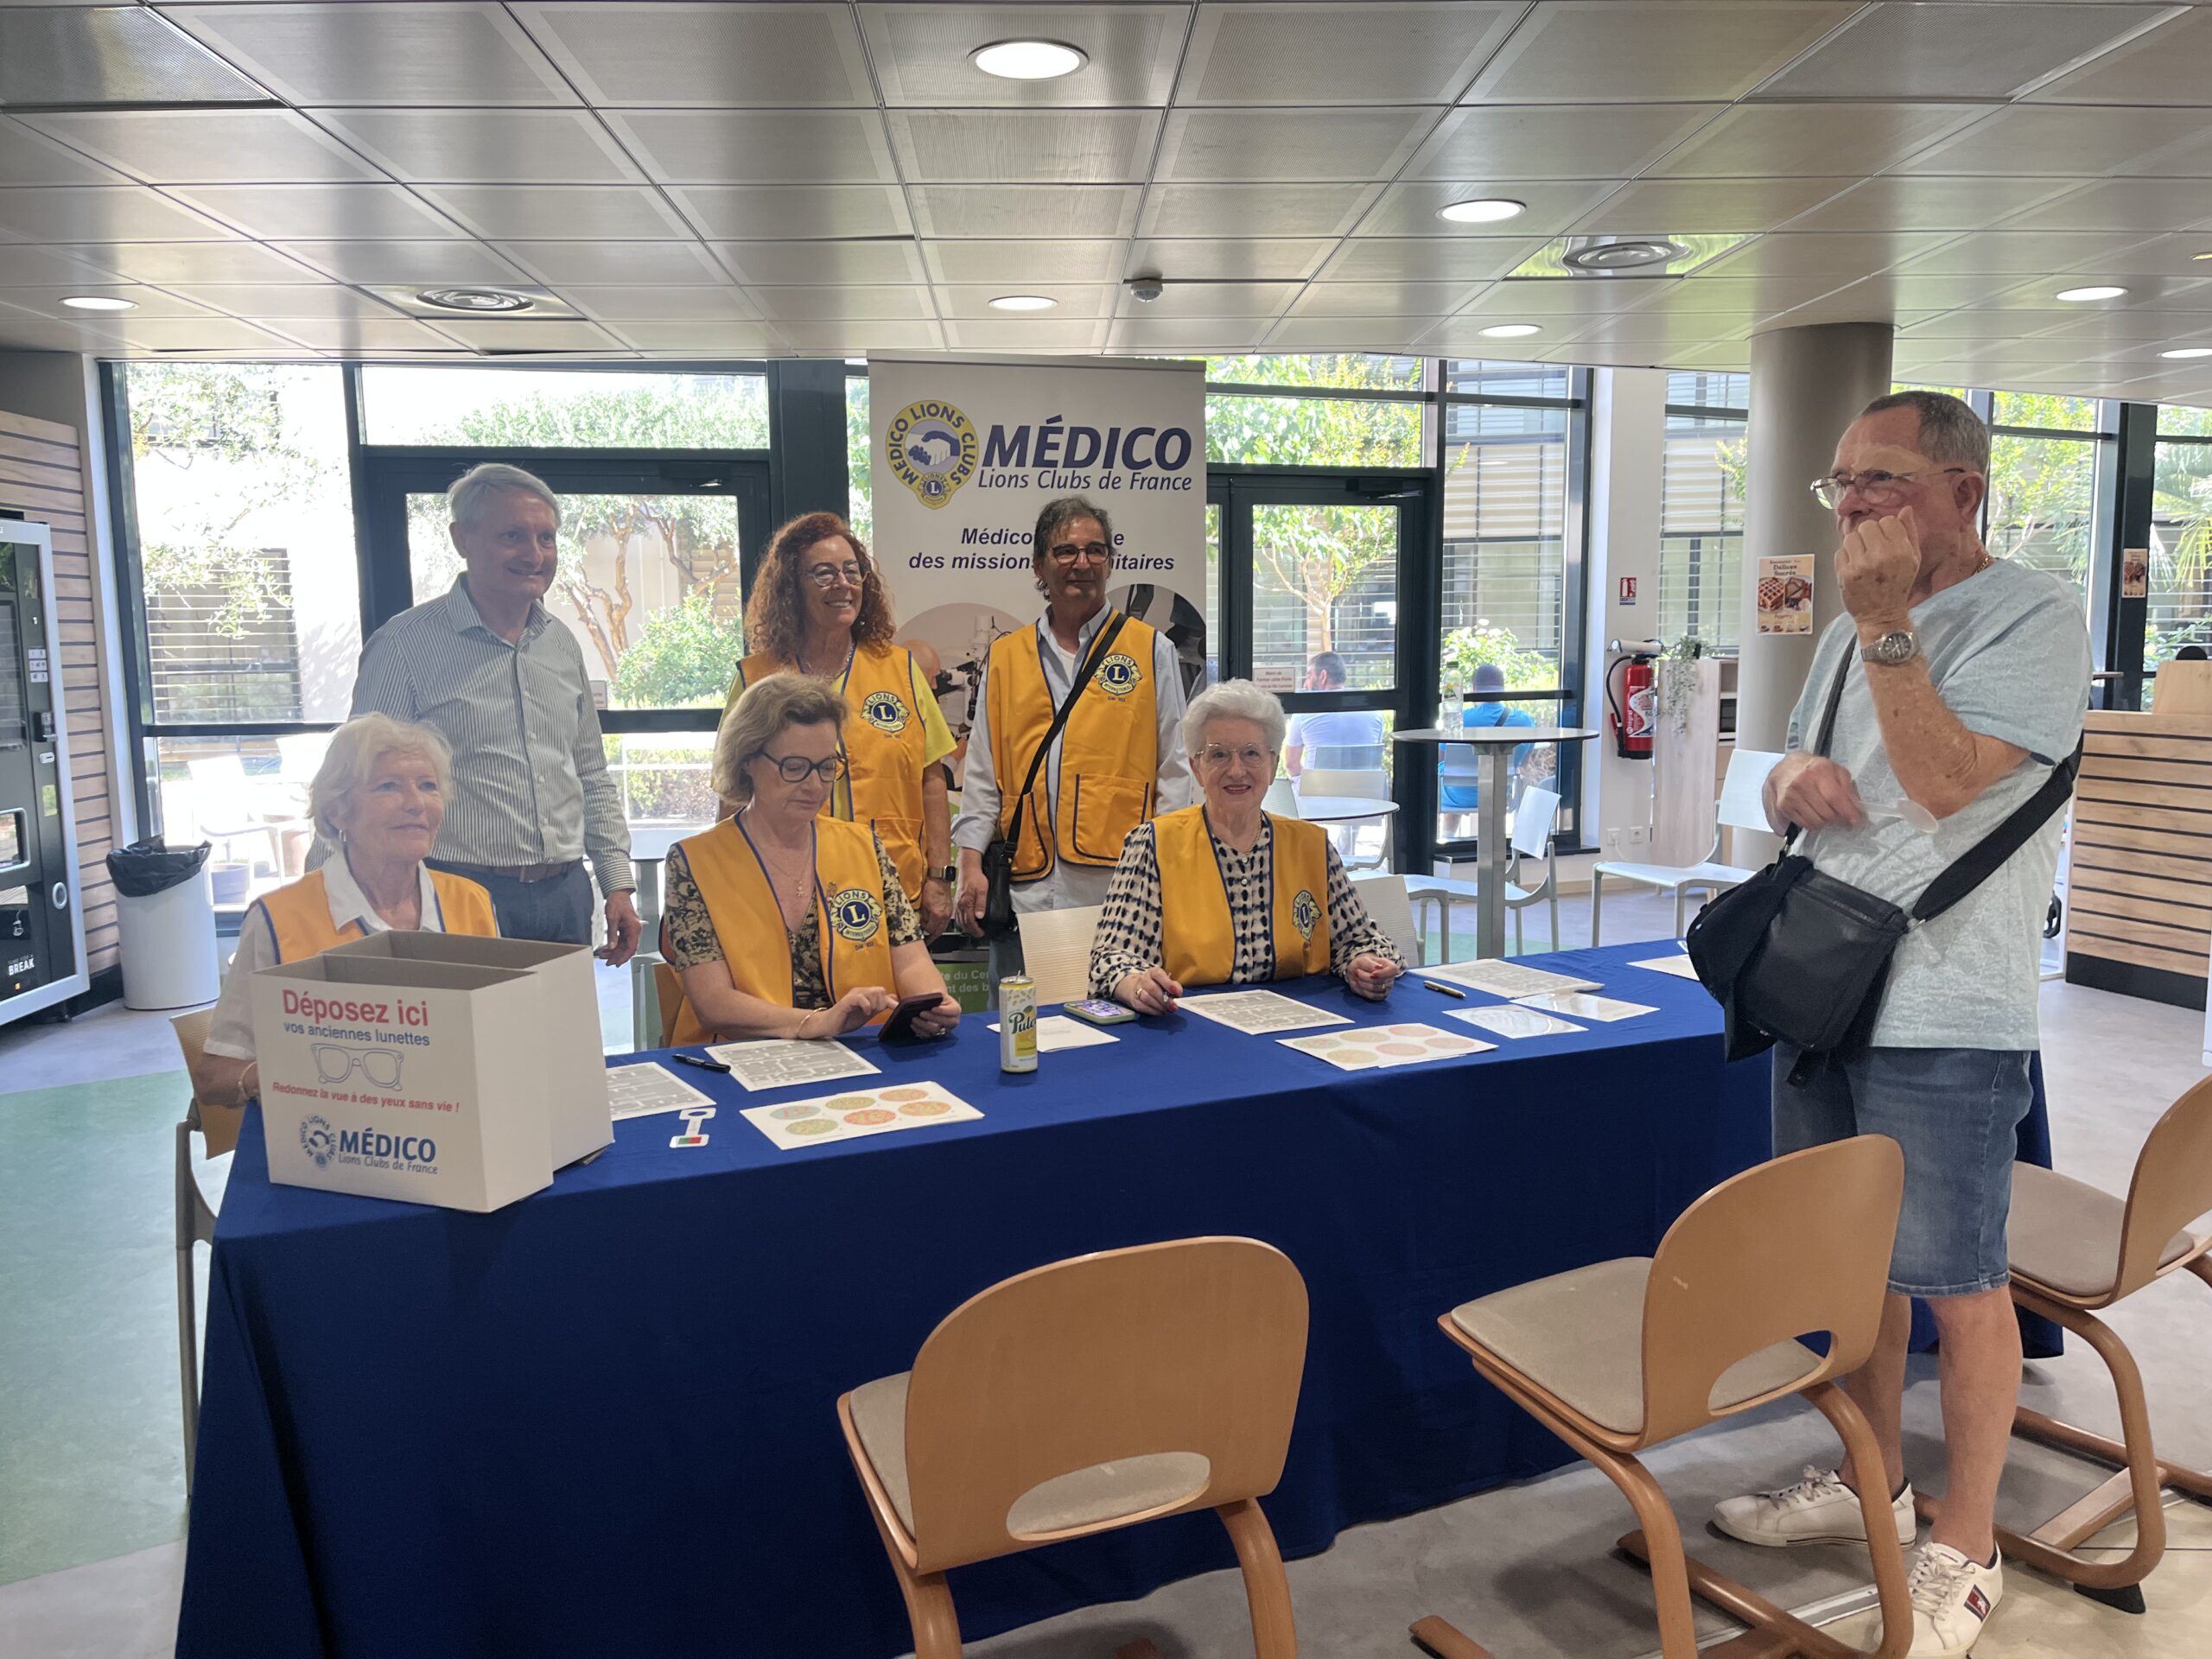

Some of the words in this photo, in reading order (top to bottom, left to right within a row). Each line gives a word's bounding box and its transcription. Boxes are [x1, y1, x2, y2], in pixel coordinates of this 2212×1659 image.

[888, 417, 919, 486] MEDICO
[910, 403, 964, 429] LIONS
[950, 432, 976, 485] CLUBS
[982, 414, 1192, 471] MÉDICO
[978, 469, 1029, 488] Lions
[1038, 470, 1091, 490] Clubs
[1098, 471, 1122, 490] de
[1129, 472, 1192, 491] France
[961, 527, 1033, 545] Médico
[909, 552, 945, 569] des
[951, 552, 1034, 569] mission
[1105, 655, 1132, 665] LIONS
[1112, 666, 1125, 681] L
[868, 693, 896, 705] LIONS
[878, 705, 893, 720] L
[836, 891, 867, 906] LIONS
[847, 905, 867, 924] L
[8, 957, 35, 976] BREAK
[953, 970, 968, 980] du
[959, 982, 979, 993] des
[282, 988, 390, 1025] Déposez
[397, 999, 429, 1027] ici
[283, 1021, 304, 1034] vos
[308, 1025, 372, 1042] anciennes
[375, 1028, 430, 1046] lunettes
[272, 1082, 319, 1098] Redonnez
[320, 1088, 329, 1099] la
[331, 1091, 348, 1102] vue
[351, 1091, 358, 1103] à
[359, 1094, 378, 1105] des
[380, 1096, 406, 1108] yeux
[408, 1100, 435, 1111] sans
[436, 1101, 453, 1112] vie
[454, 1102, 460, 1113] !
[339, 1127, 436, 1163] MÉDICO
[338, 1154, 362, 1166] Lions
[364, 1156, 390, 1169] Clubs
[392, 1159, 404, 1171] de
[407, 1161, 439, 1175] France
